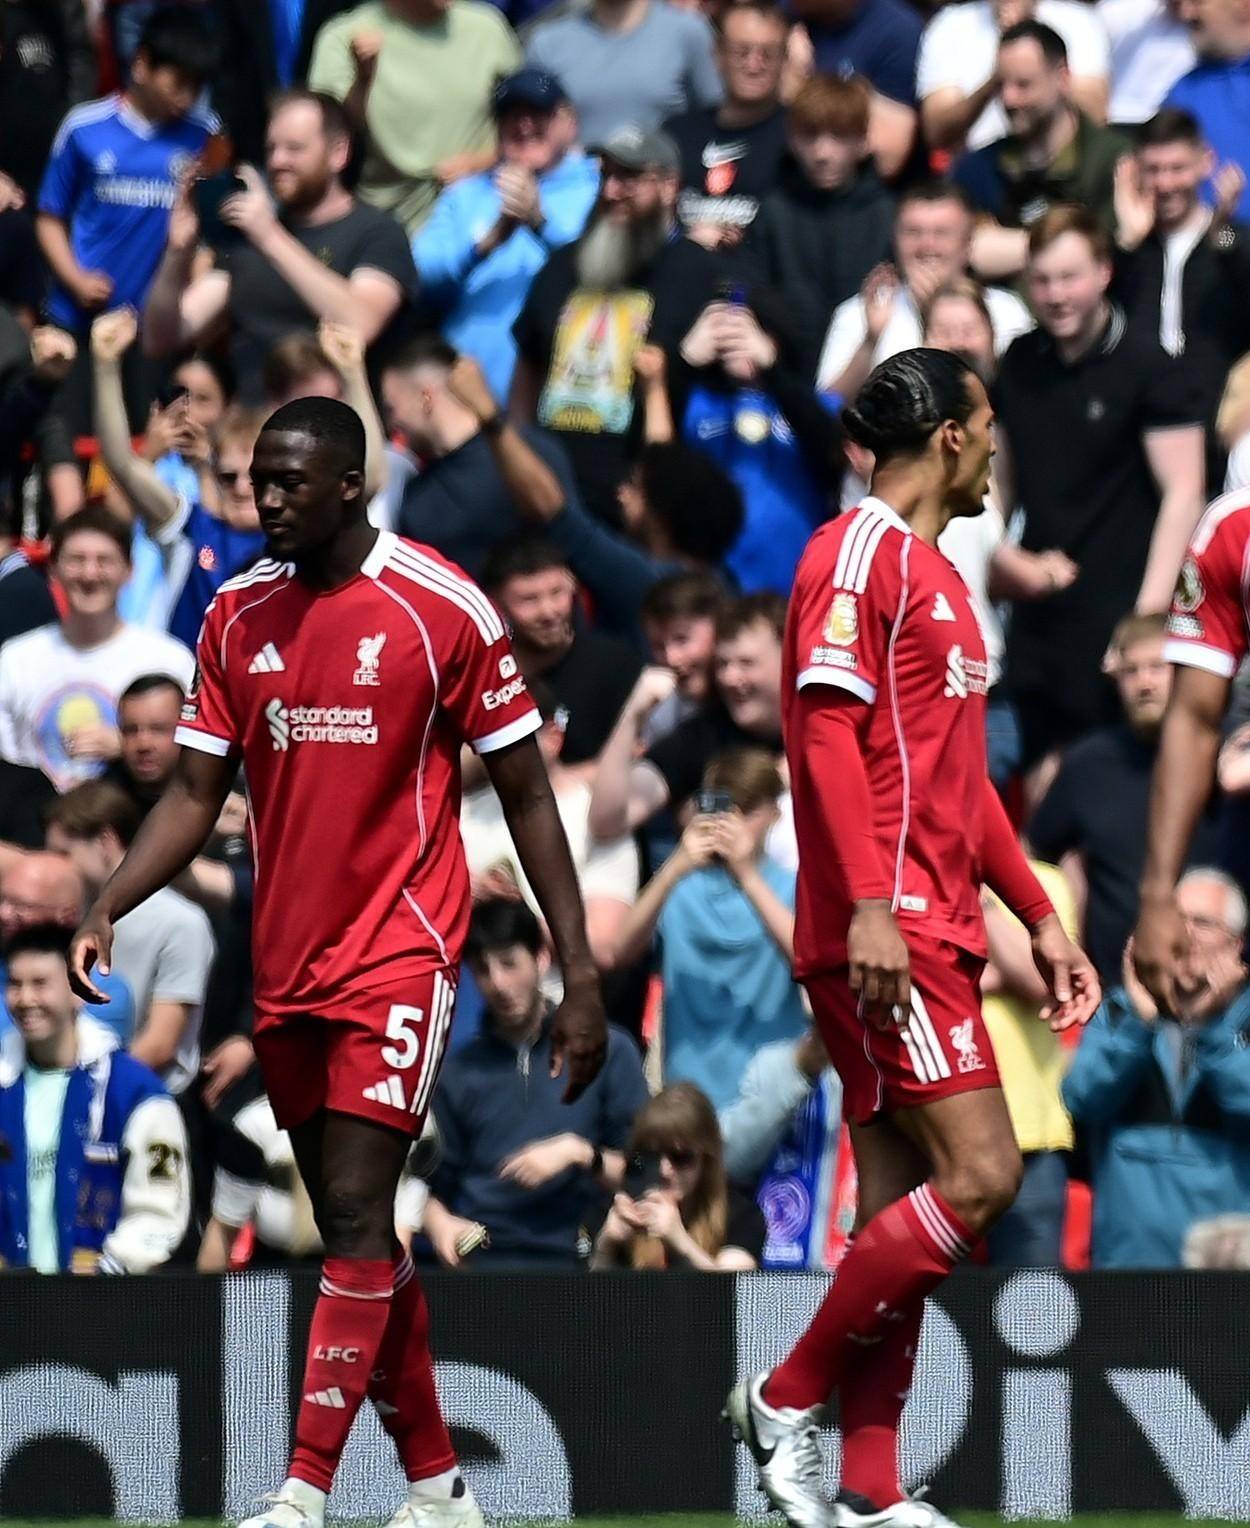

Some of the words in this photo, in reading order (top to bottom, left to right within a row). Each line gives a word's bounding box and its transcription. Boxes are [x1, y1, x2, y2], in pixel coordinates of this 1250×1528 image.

[289, 704, 373, 725] standard
[291, 724, 378, 744] chartered
[380, 1003, 424, 1070] 5
[312, 1344, 360, 1363] LFC
